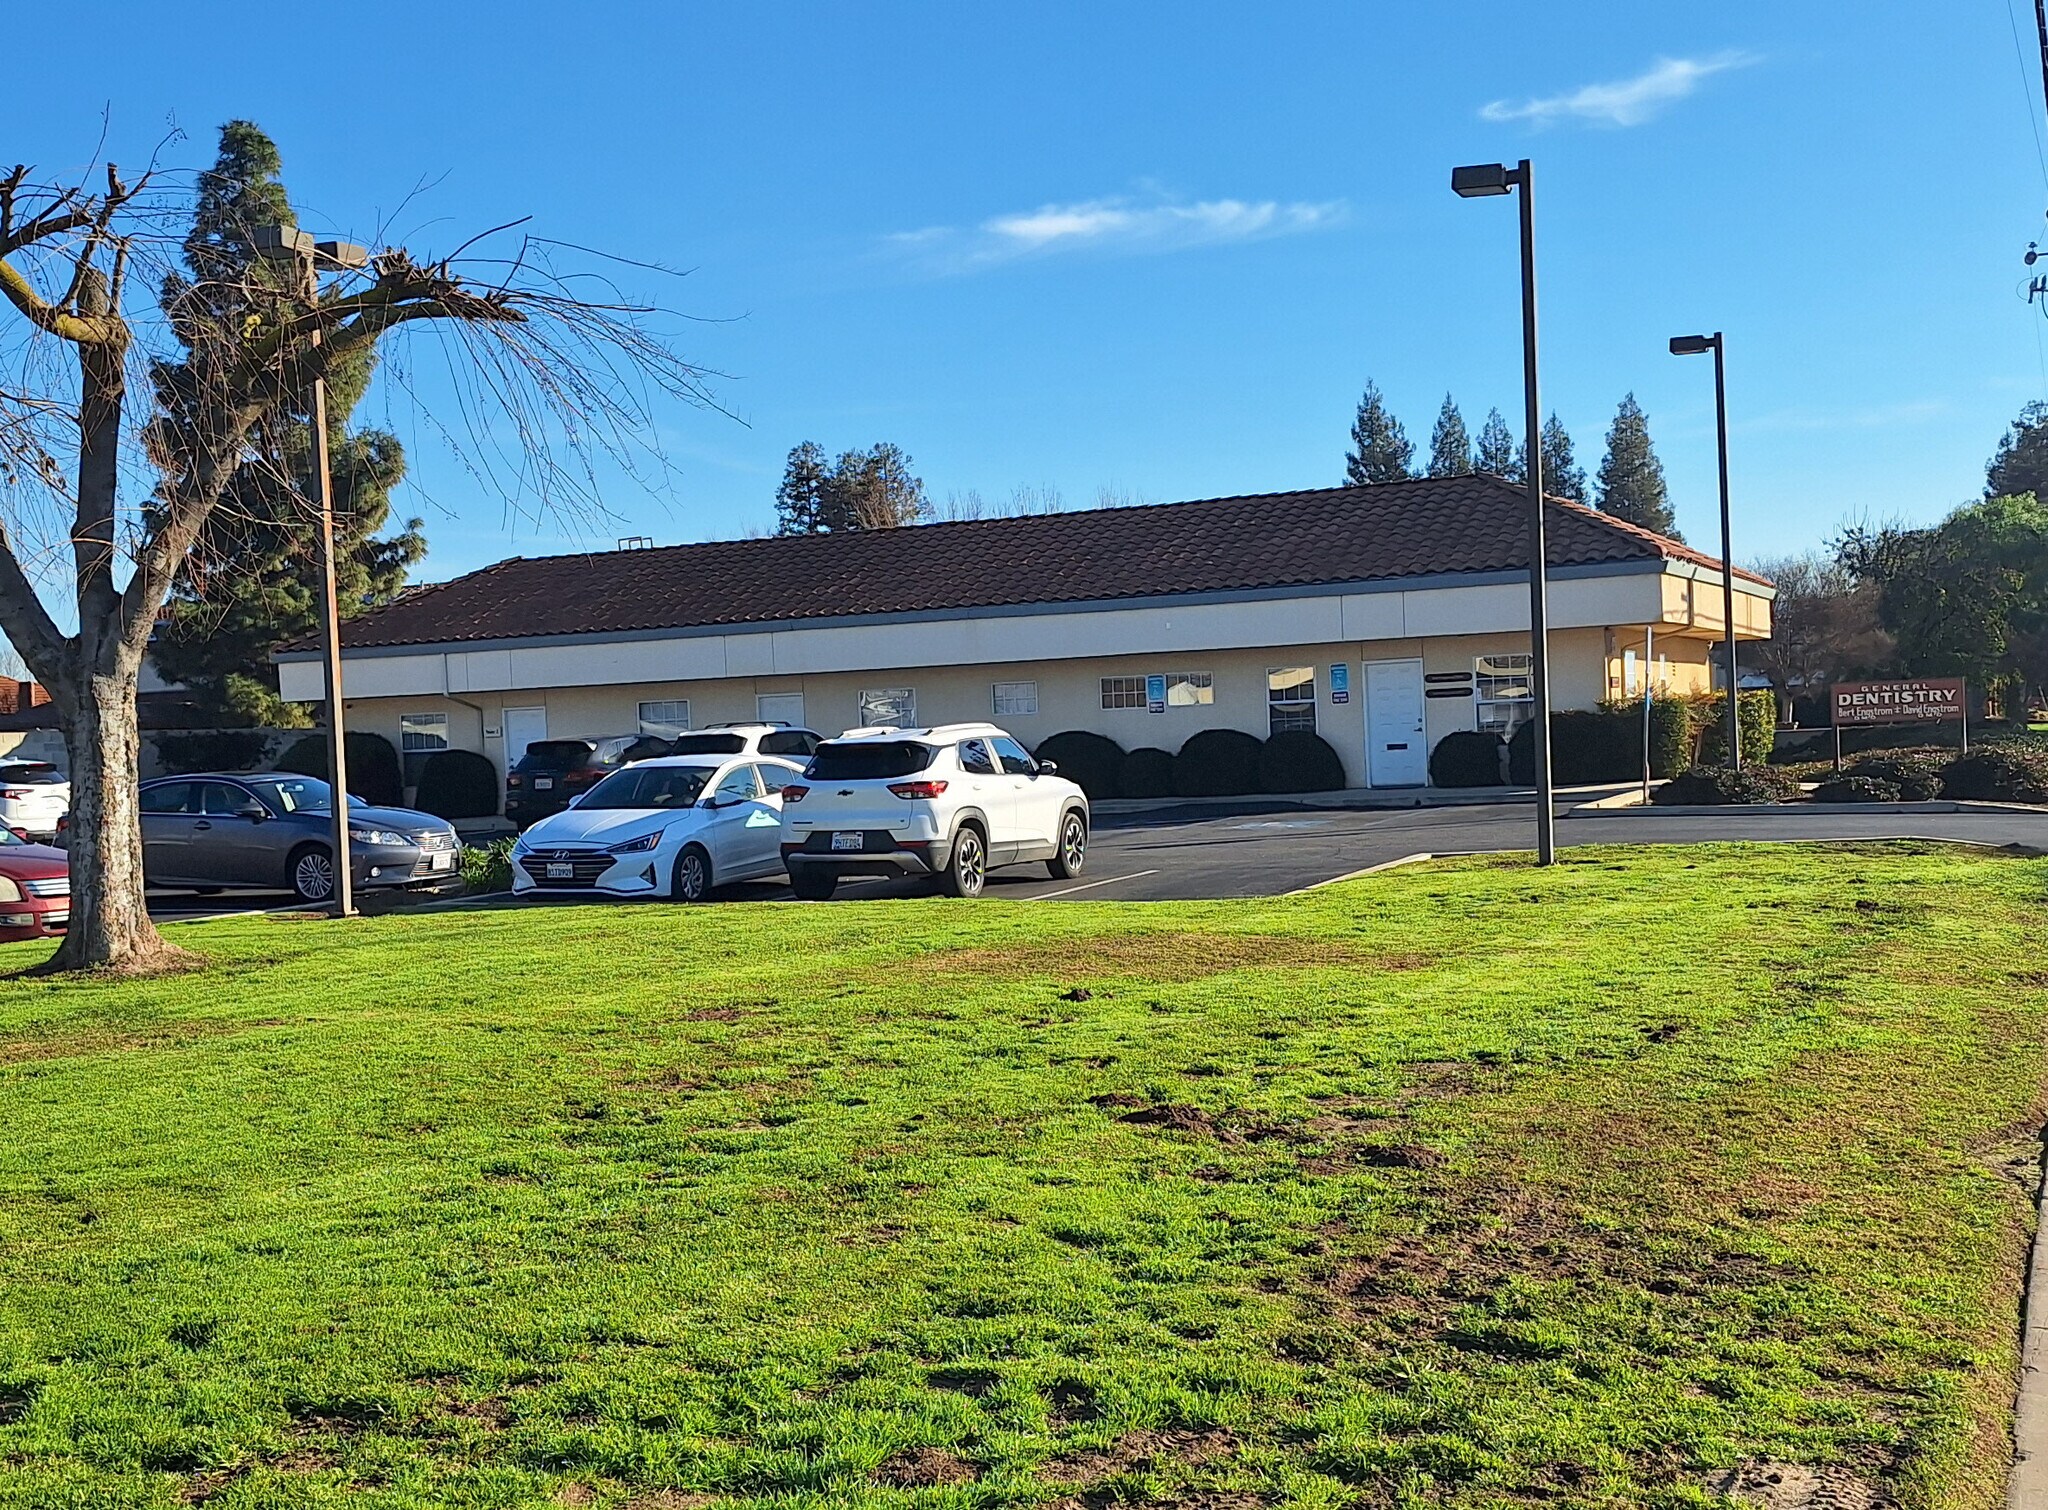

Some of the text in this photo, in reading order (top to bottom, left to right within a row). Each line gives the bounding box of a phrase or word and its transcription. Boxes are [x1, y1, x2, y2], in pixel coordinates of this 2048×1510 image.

[1861, 683, 1930, 692] GENERAL
[1838, 689, 1957, 706] DENTISTRY
[1838, 707, 1854, 718] Bert
[1856, 706, 1893, 718] Engstrom
[1903, 704, 1922, 715] David
[1923, 703, 1959, 716] Engstrom
